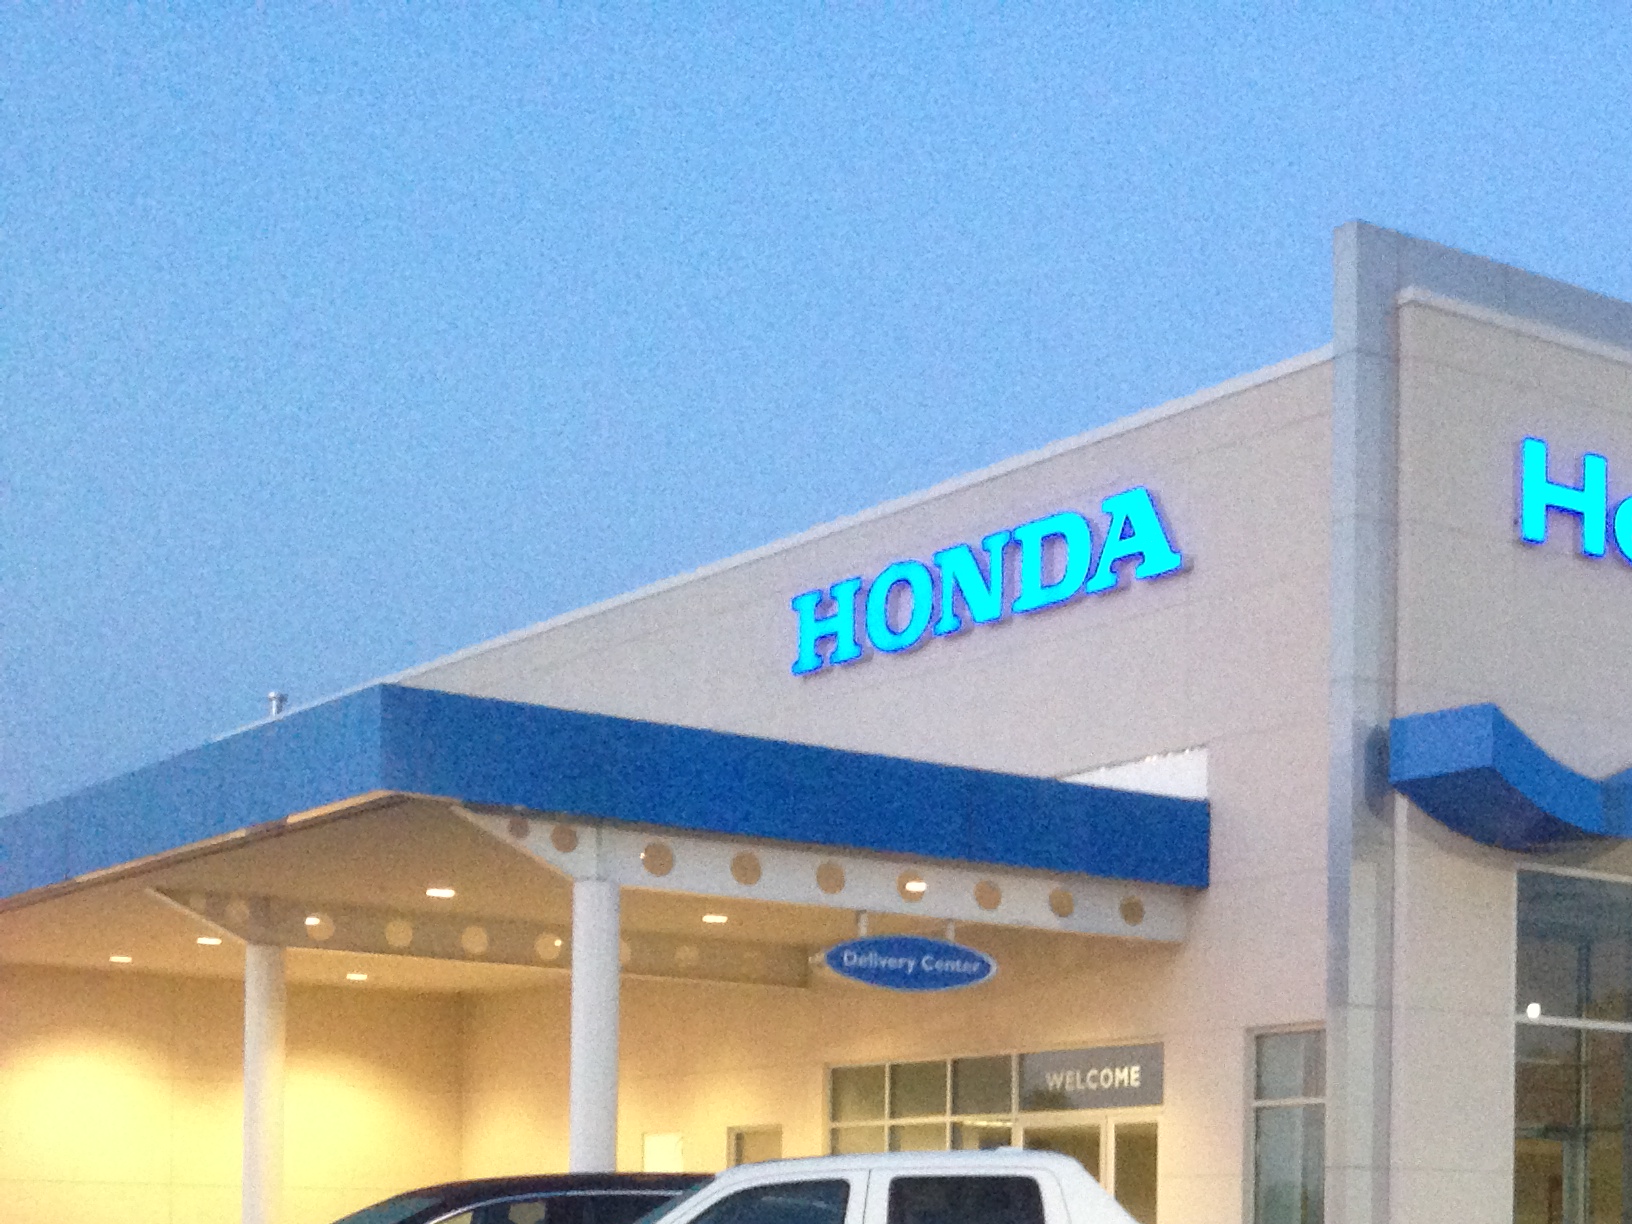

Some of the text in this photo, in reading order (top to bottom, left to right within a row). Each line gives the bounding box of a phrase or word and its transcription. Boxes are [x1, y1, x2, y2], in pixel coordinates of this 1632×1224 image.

[790, 486, 1185, 676] HONDA
[843, 951, 981, 975] Delivery Center
[1046, 1065, 1141, 1092] WELCOME
